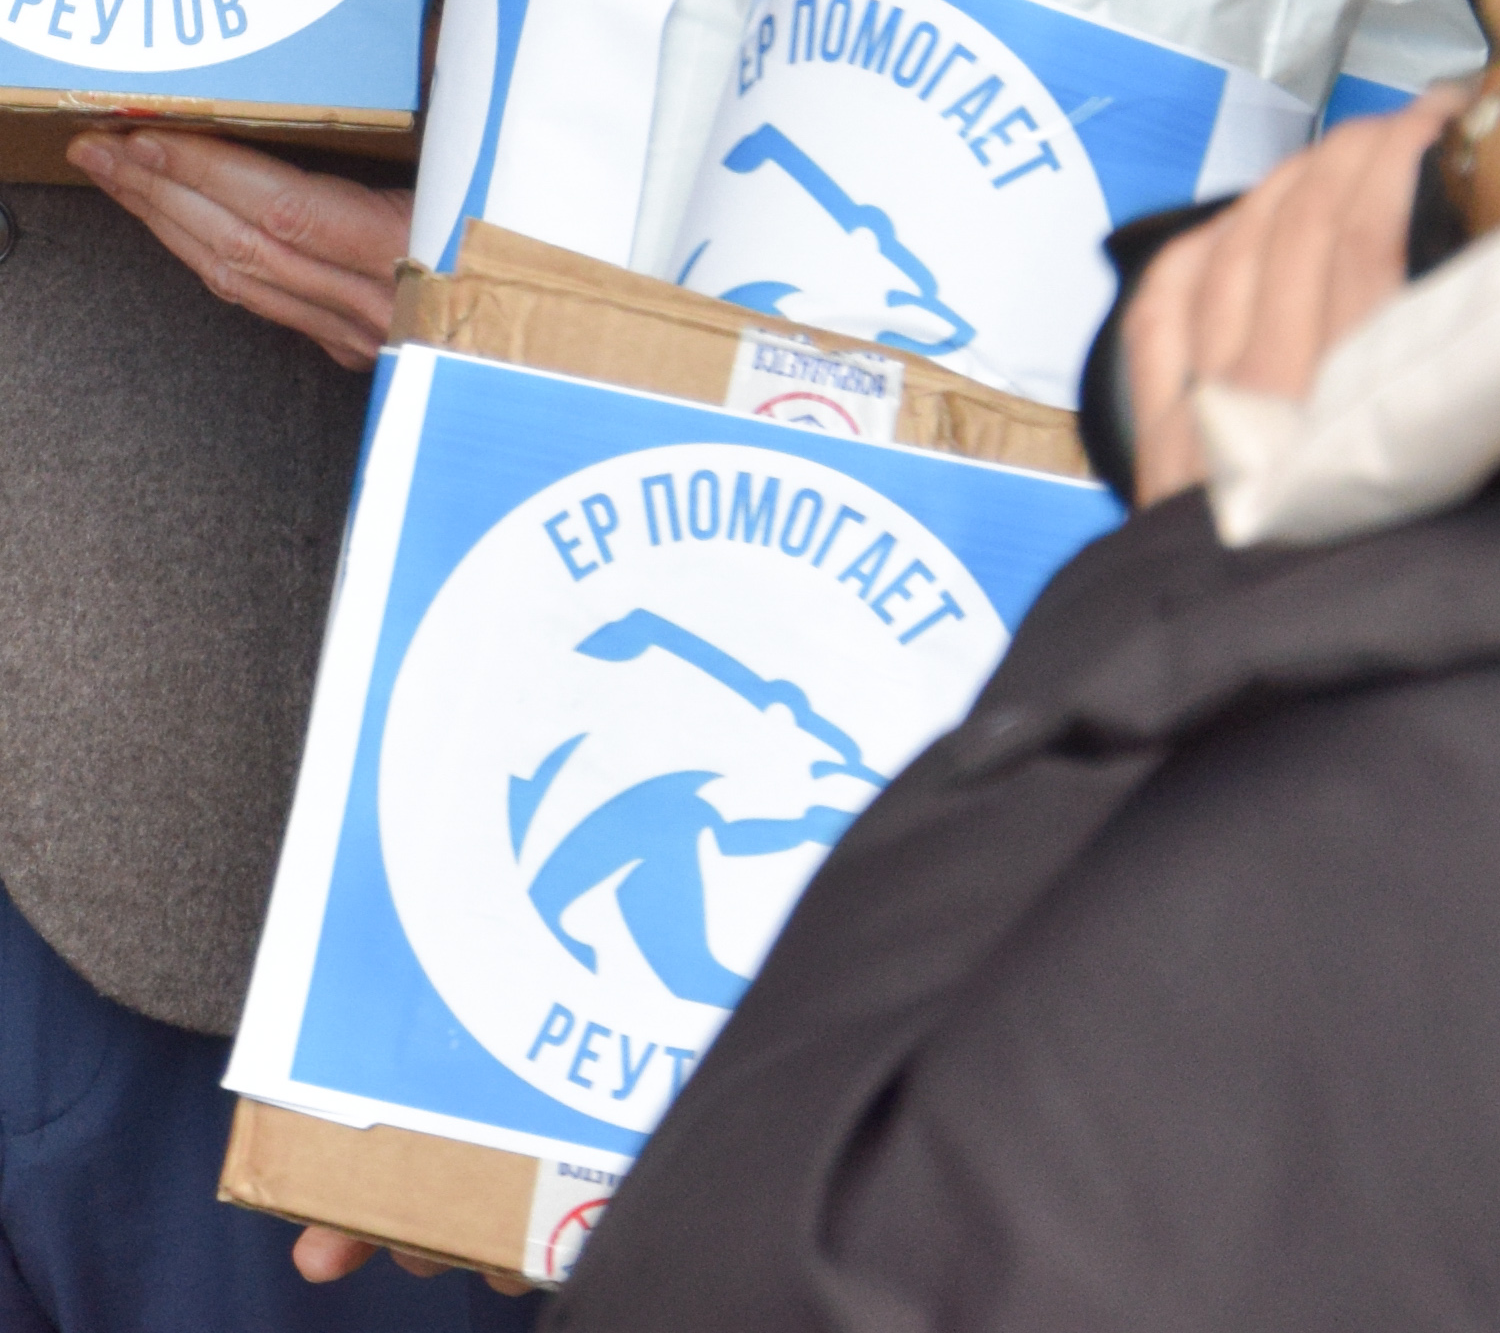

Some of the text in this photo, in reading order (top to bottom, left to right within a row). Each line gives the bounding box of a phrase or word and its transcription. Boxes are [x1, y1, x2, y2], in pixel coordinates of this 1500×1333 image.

[738, 13, 776, 98] ЕР
[542, 469, 967, 646] ЕР ПОМОГАЕТ
[525, 1001, 699, 1102] РЕУТ
